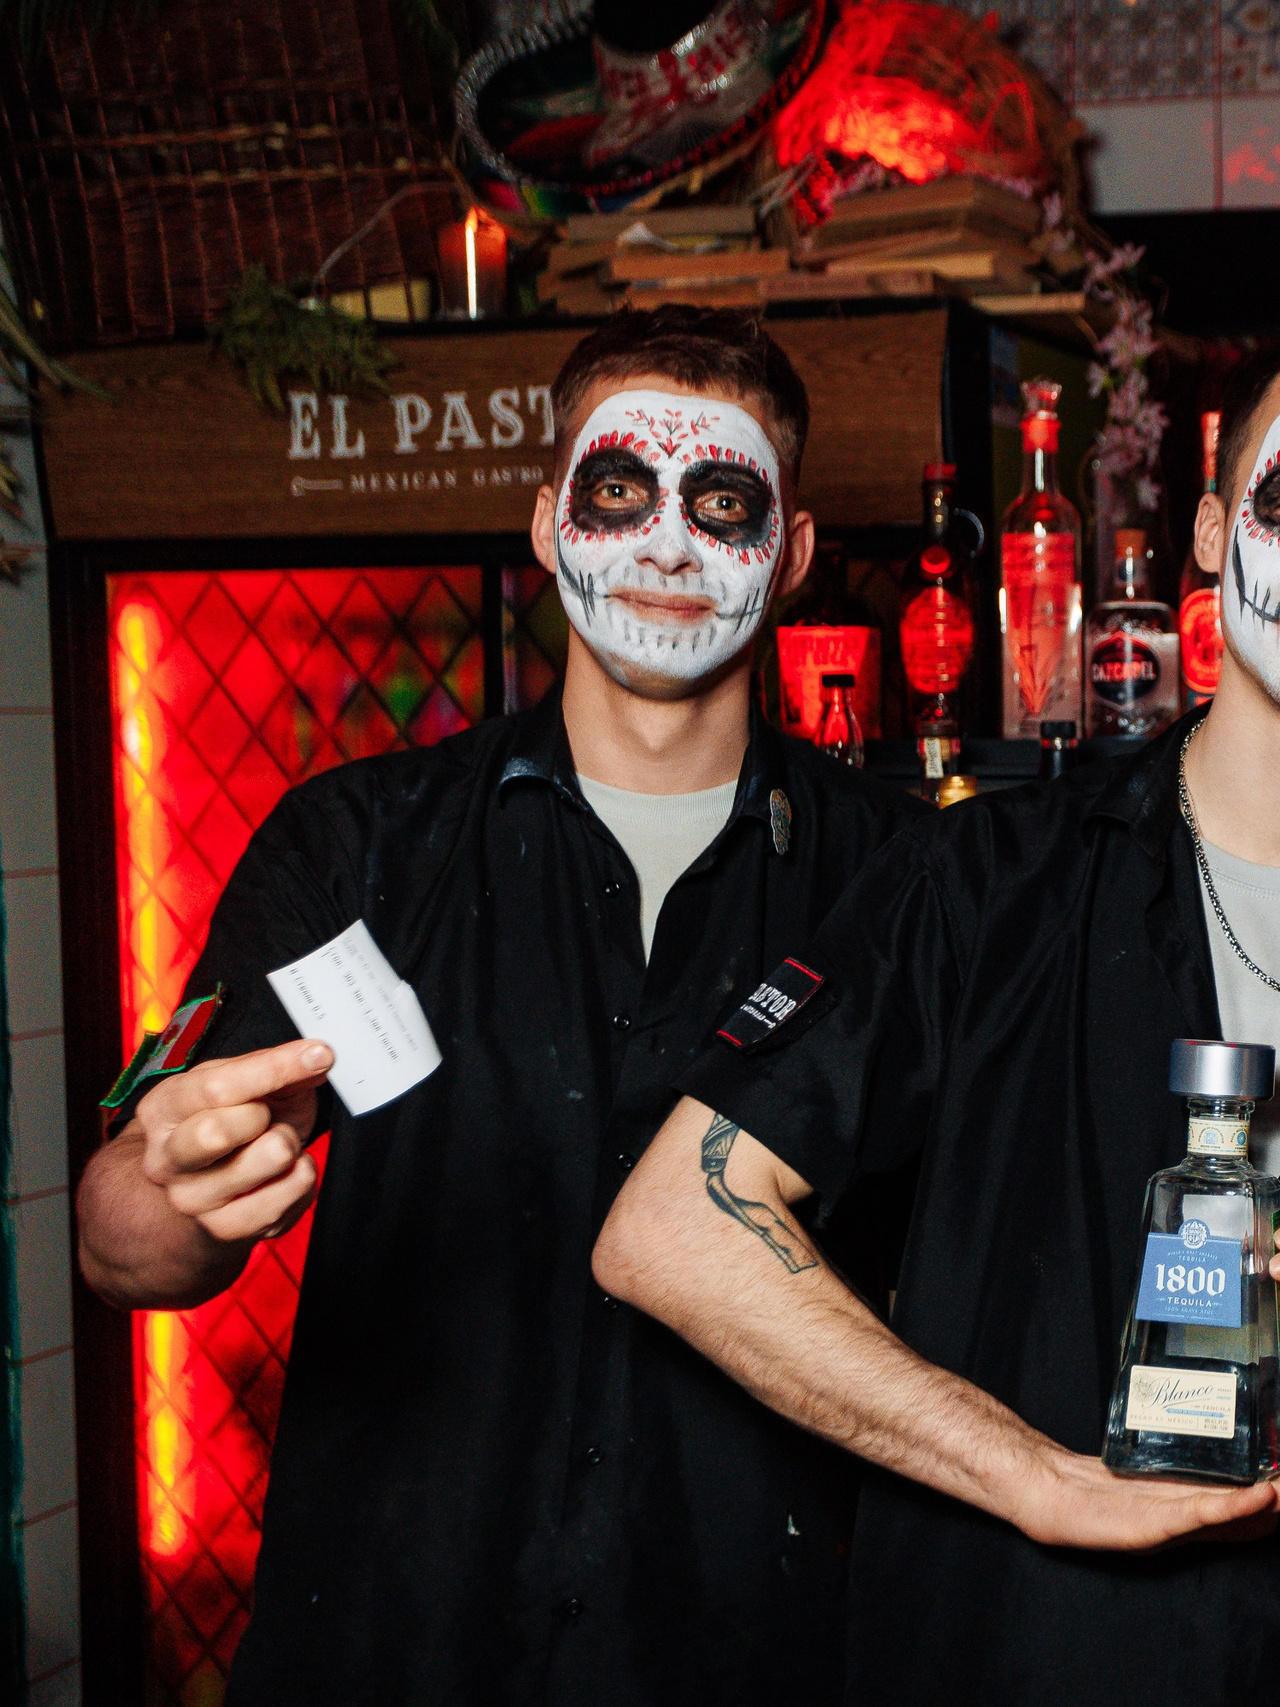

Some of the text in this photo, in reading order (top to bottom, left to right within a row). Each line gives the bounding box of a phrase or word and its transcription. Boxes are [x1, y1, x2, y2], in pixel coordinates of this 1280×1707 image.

[288, 390, 365, 460] EL
[350, 467, 457, 493] MEXICAN
[1155, 1263, 1226, 1296] 1800
[1167, 1296, 1212, 1308] TEQUILA
[1148, 1376, 1213, 1408] Blanco
